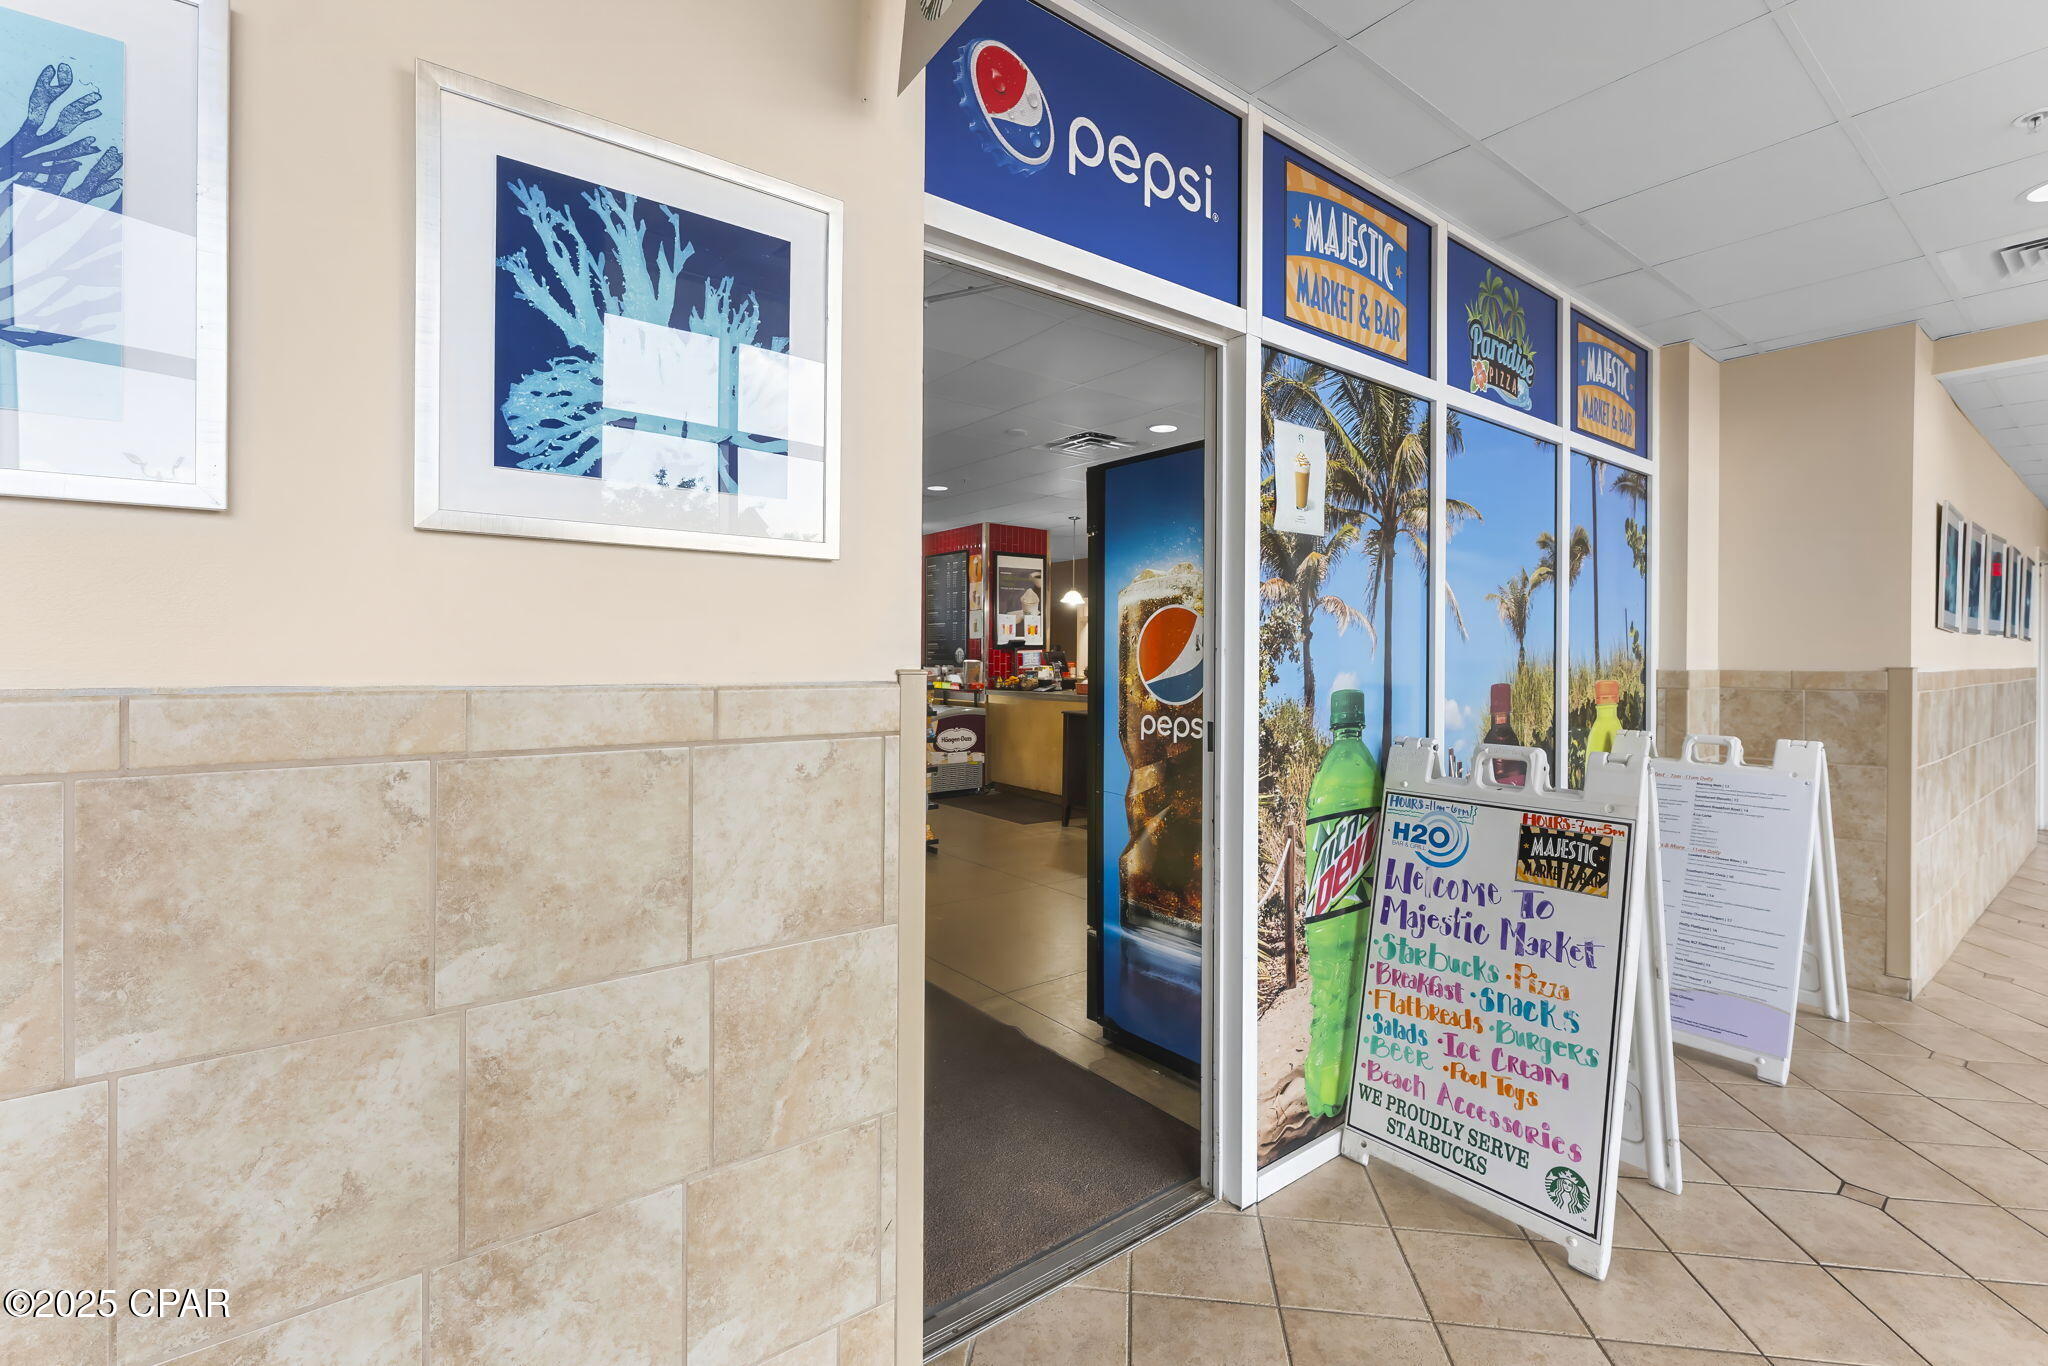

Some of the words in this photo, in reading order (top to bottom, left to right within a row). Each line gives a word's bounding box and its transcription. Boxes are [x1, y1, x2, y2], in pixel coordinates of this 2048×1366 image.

[1068, 116, 1212, 219] pepsi
[1305, 200, 1394, 291] MAJESTIC
[1296, 265, 1354, 324] MARKET
[1358, 293, 1370, 330] &
[1375, 299, 1401, 342] BAR
[1470, 323, 1534, 385] Paradise
[1489, 366, 1517, 395] PIZZA
[1586, 345, 1629, 401] MAJESTIC
[1582, 394, 1610, 427] MARKET
[1611, 405, 1618, 431] &
[1619, 409, 1633, 436] BAR
[1140, 714, 1203, 744] peps
[1392, 821, 1450, 849] H2O
[1530, 836, 1599, 867] MAJESTIC
[1384, 857, 1502, 907] Welcome
[1510, 889, 1555, 920] To
[1379, 895, 1490, 945] Majestic
[1500, 918, 1606, 969] Market
[1375, 960, 1465, 1004] Breakfast
[1478, 987, 1581, 1034] Snacks
[1377, 932, 1500, 984] Starbucks
[1513, 962, 1571, 1002] Pizza
[1372, 1012, 1429, 1047] Salads
[1442, 1032, 1482, 1063] Ice
[1490, 1046, 1570, 1090] Cream
[1374, 988, 1484, 1035] Flatbreads
[1495, 1019, 1600, 1068] Burgers
[1366, 1059, 1426, 1101] Beach
[1436, 1082, 1584, 1164] Accessories
[1450, 1061, 1488, 1090] Pool
[1491, 1074, 1540, 1112] Toys
[1359, 1082, 1383, 1108] WE
[1386, 1092, 1464, 1141] PROUDLY
[1467, 1127, 1530, 1170] SERVE
[1386, 1117, 1488, 1176] STARBUCKS
